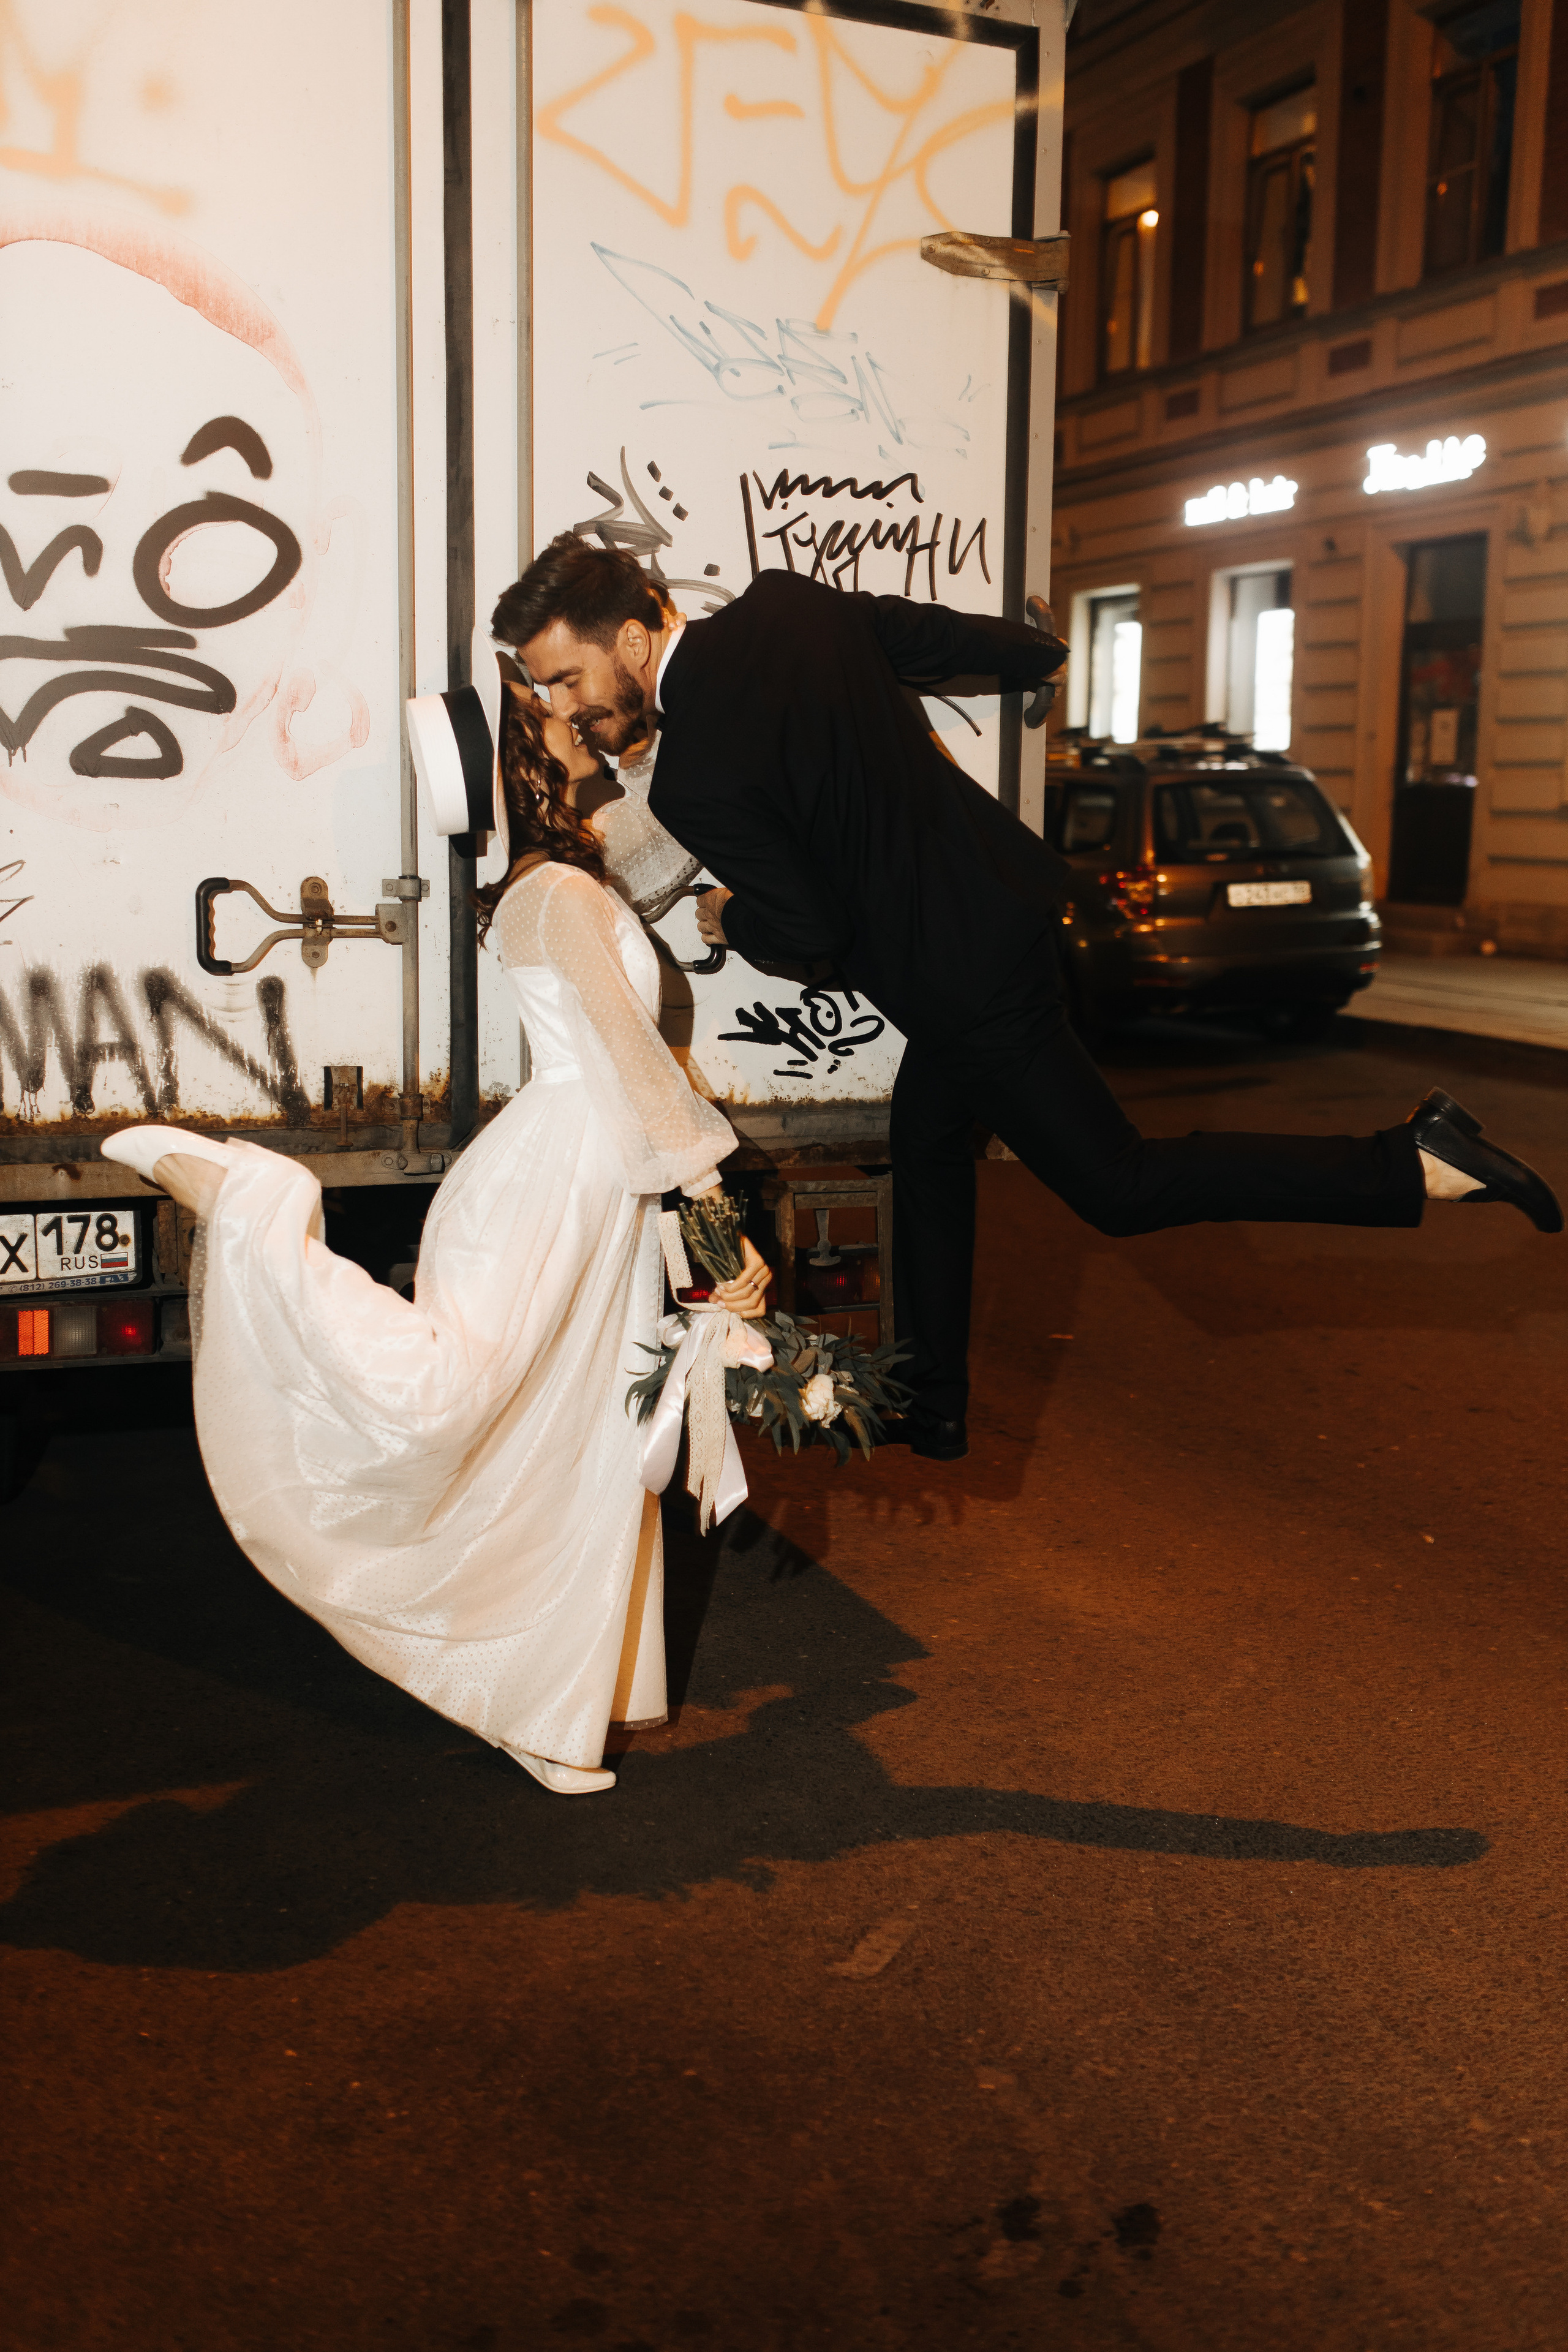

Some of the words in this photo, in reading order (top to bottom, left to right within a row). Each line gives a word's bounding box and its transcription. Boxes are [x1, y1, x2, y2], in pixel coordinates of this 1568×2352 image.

[41, 1213, 119, 1256] 178
[61, 1255, 99, 1271] RUS
[20, 1283, 45, 1292] (812)
[48, 1277, 97, 1289] 269-38-38
